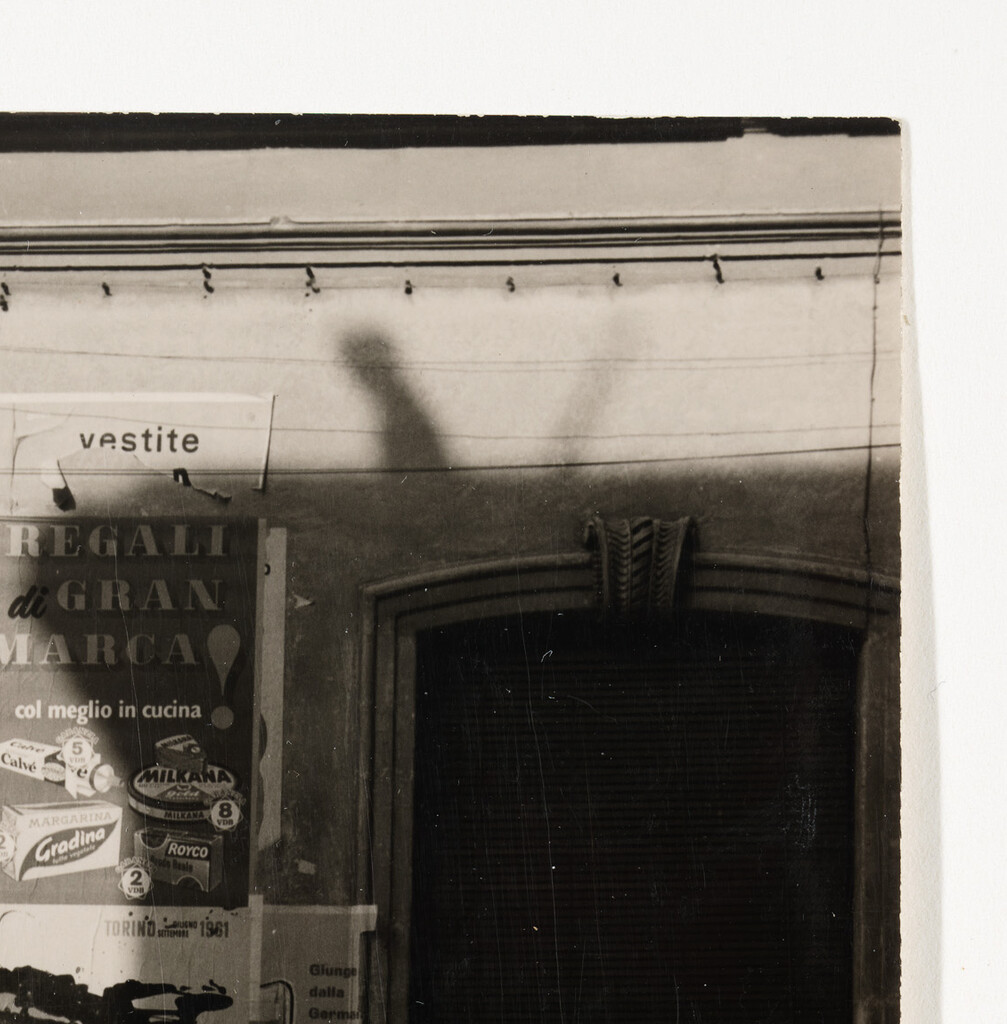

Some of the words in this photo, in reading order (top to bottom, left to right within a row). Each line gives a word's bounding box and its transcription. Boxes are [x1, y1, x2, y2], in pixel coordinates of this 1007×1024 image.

[79, 427, 199, 453] vestite
[4, 524, 230, 559] REGALI
[7, 585, 48, 619] di
[56, 579, 226, 613] GRAN
[14, 701, 42, 719] col
[47, 700, 113, 725] meglio
[118, 701, 136, 719] in
[141, 701, 202, 719] cucina
[71, 741, 83, 756] 5
[0, 752, 37, 773] Calvé
[137, 769, 231, 783] MILKANA
[164, 811, 205, 819] MILKANA
[218, 802, 232, 818] 8
[28, 811, 113, 829] MARGARINA
[35, 827, 106, 862] Gradina
[167, 842, 209, 859] ROYCO
[130, 870, 143, 886] 2
[103, 919, 157, 938] TORINO
[308, 985, 345, 998] dalla
